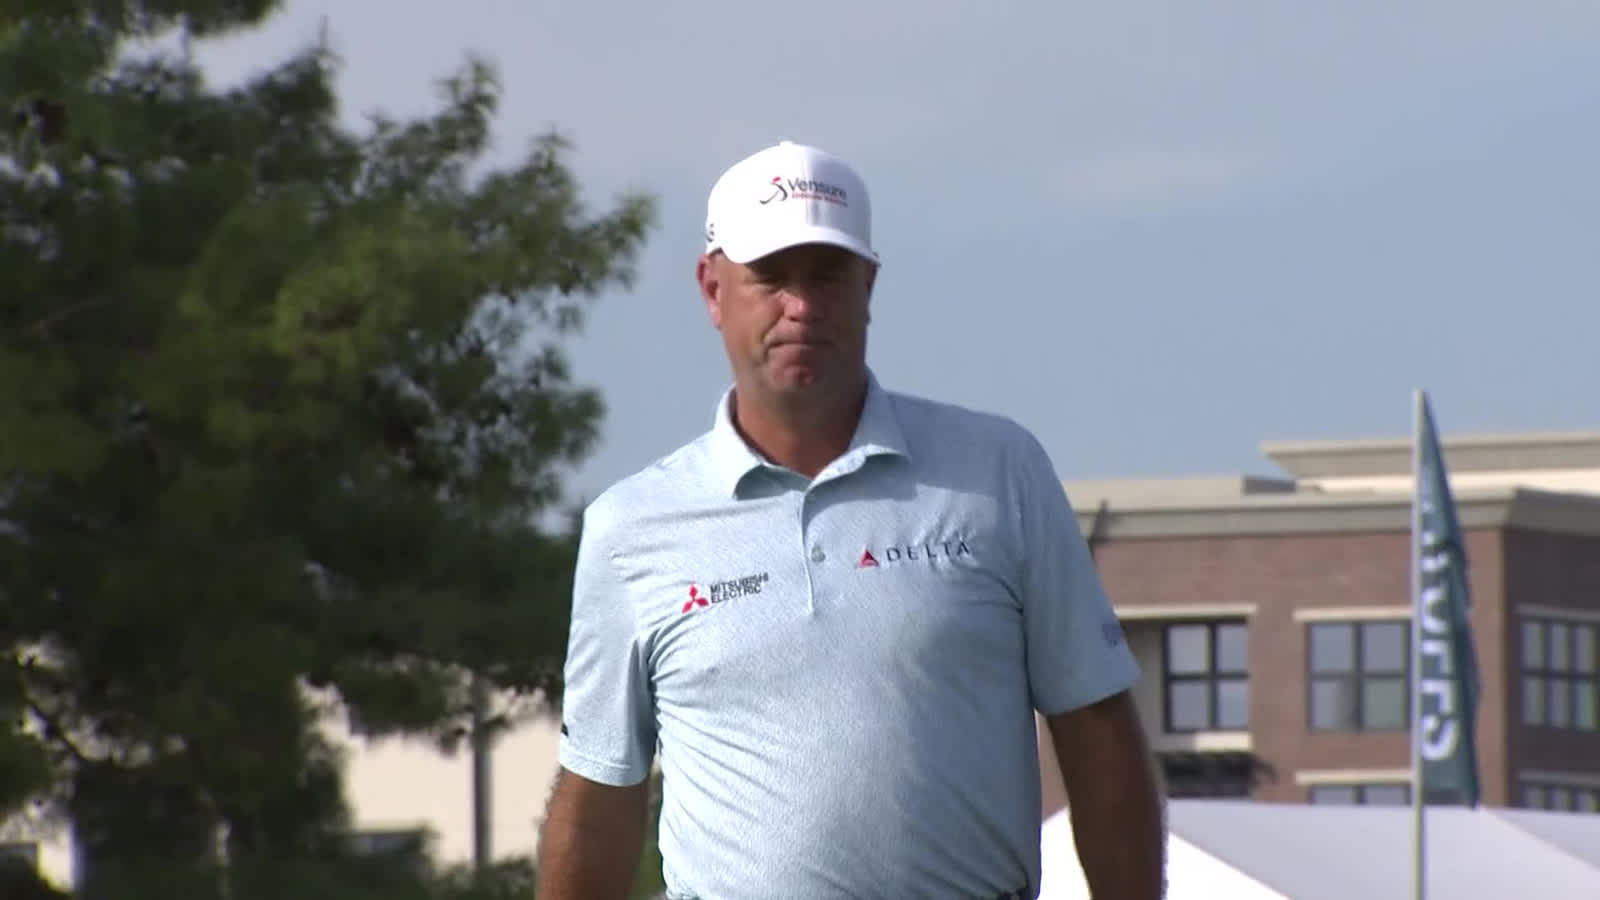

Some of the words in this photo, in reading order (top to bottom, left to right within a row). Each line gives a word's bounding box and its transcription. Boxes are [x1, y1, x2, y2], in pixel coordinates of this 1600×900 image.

[787, 178, 847, 200] Vensure
[886, 541, 969, 562] DELTA
[710, 572, 769, 593] MITSUBISHI
[711, 583, 761, 603] ELECTRIC
